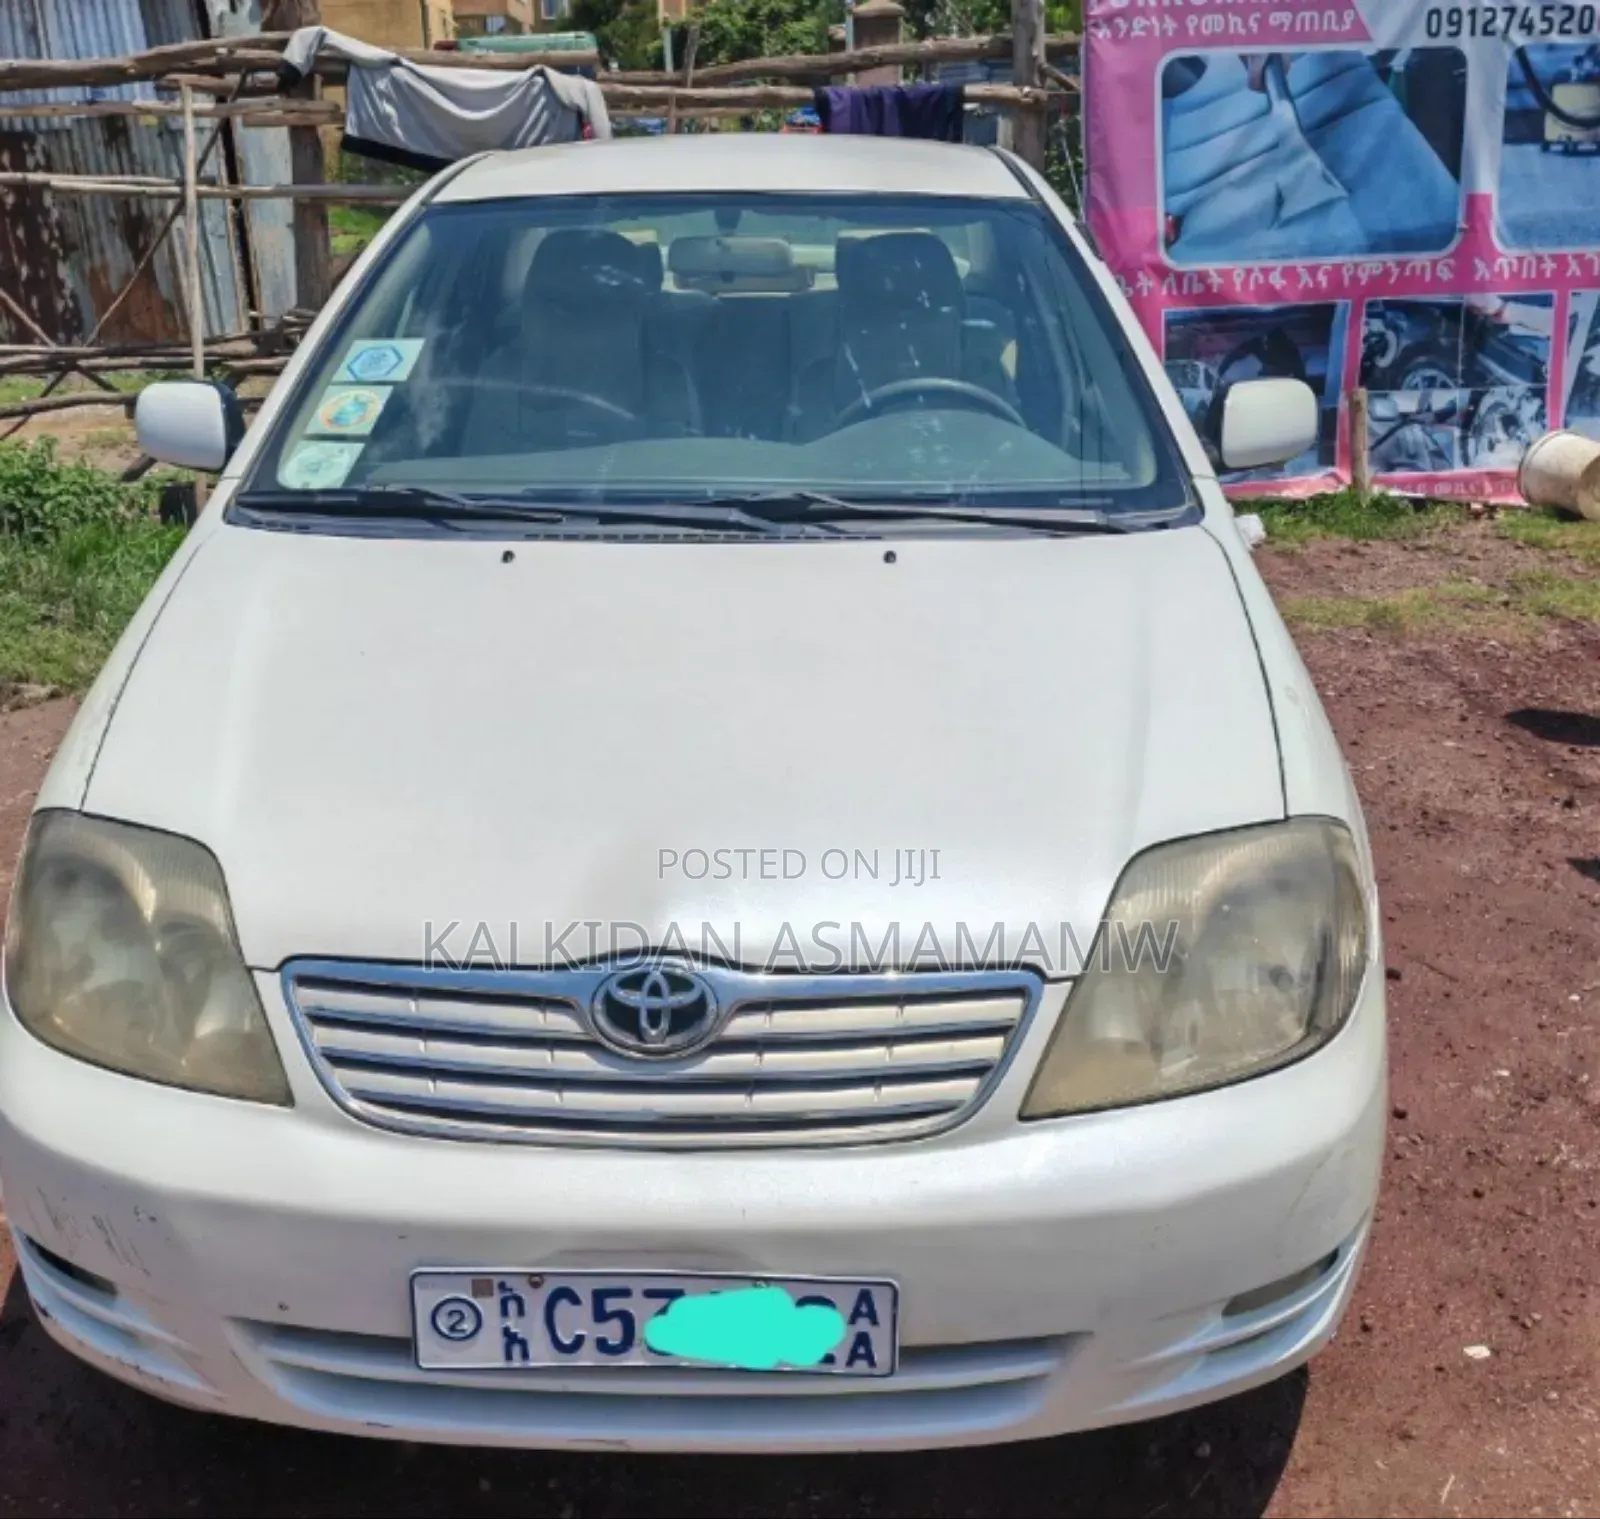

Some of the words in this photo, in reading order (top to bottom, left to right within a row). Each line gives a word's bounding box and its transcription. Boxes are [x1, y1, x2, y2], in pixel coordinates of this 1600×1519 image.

[1185, 12, 1261, 37] የመኪና
[1268, 9, 1356, 33] ማጠቢያ
[1295, 264, 1332, 290] እና
[1341, 257, 1457, 289] የምንጣፍ
[447, 1309, 467, 1333] 2
